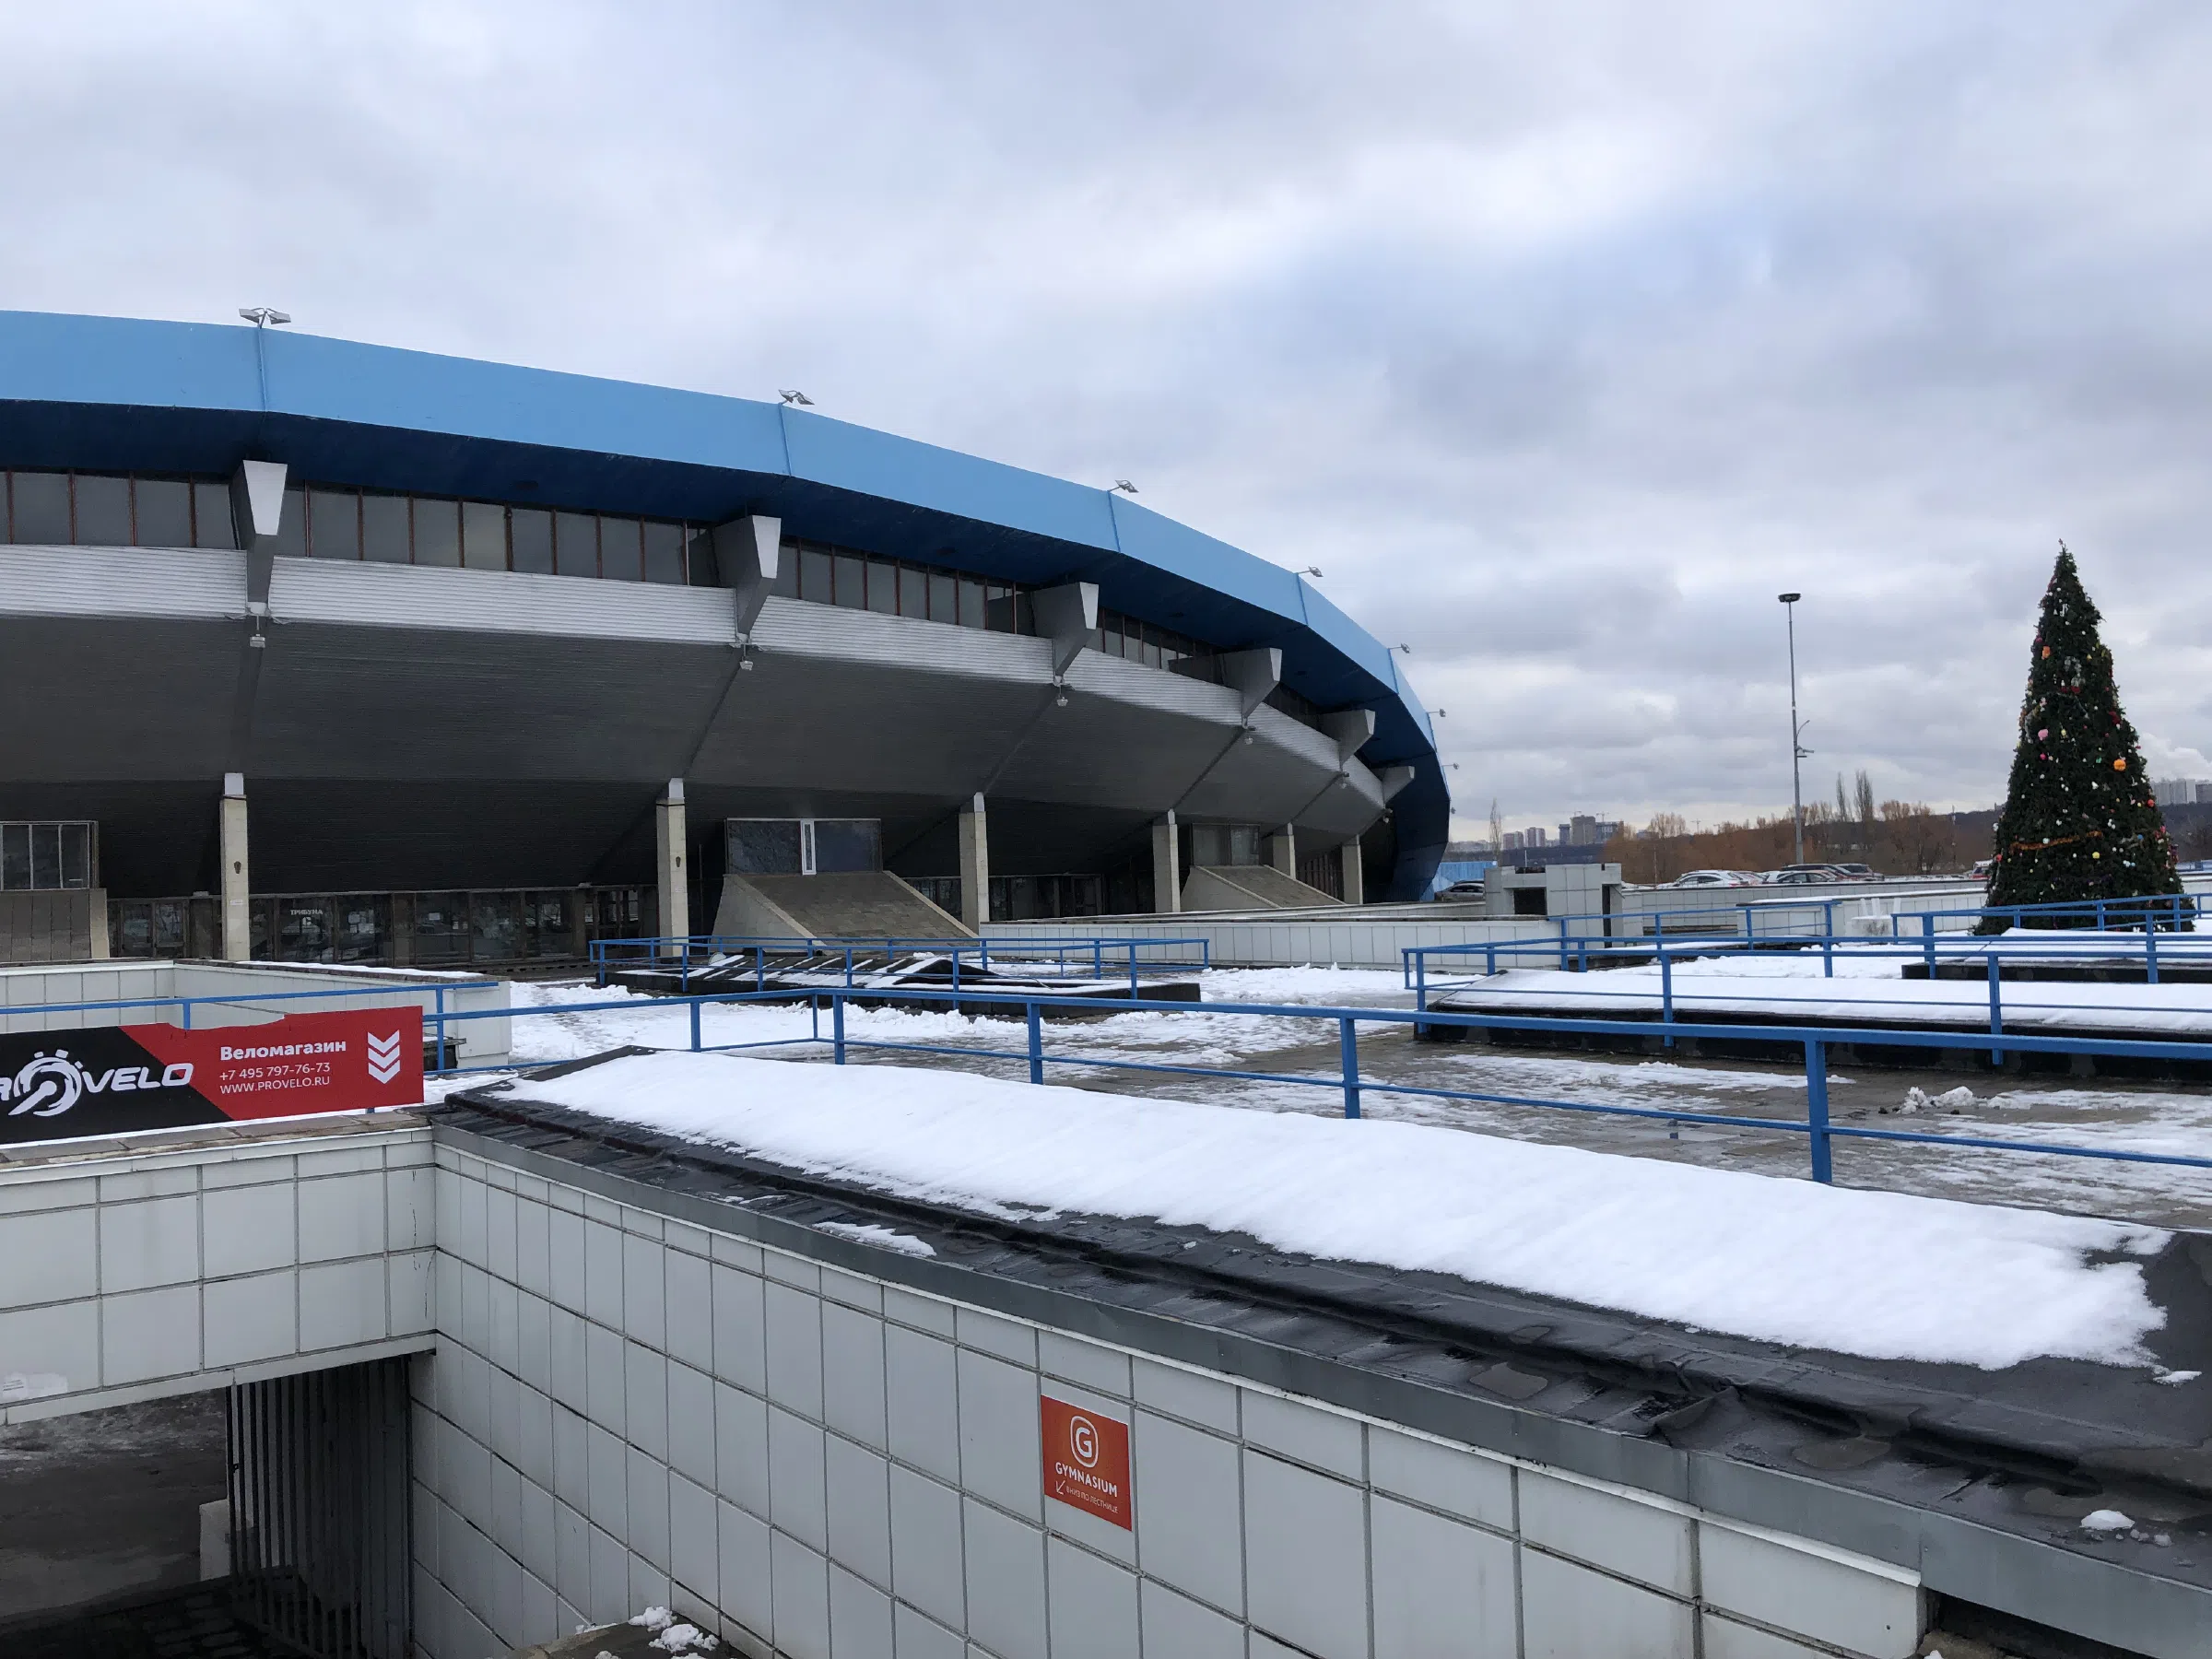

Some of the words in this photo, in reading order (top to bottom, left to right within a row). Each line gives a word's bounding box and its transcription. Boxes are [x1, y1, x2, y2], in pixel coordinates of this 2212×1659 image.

[220, 1041, 347, 1061] Веломагазин
[219, 1069, 236, 1081] +7
[240, 1067, 264, 1079] 495
[266, 1062, 331, 1077] 797-76-73
[220, 1076, 331, 1095] WWW.PROVELO.RU
[1055, 1462, 1117, 1497] GYMNASIUM
[1081, 1491, 1089, 1501] ПО
